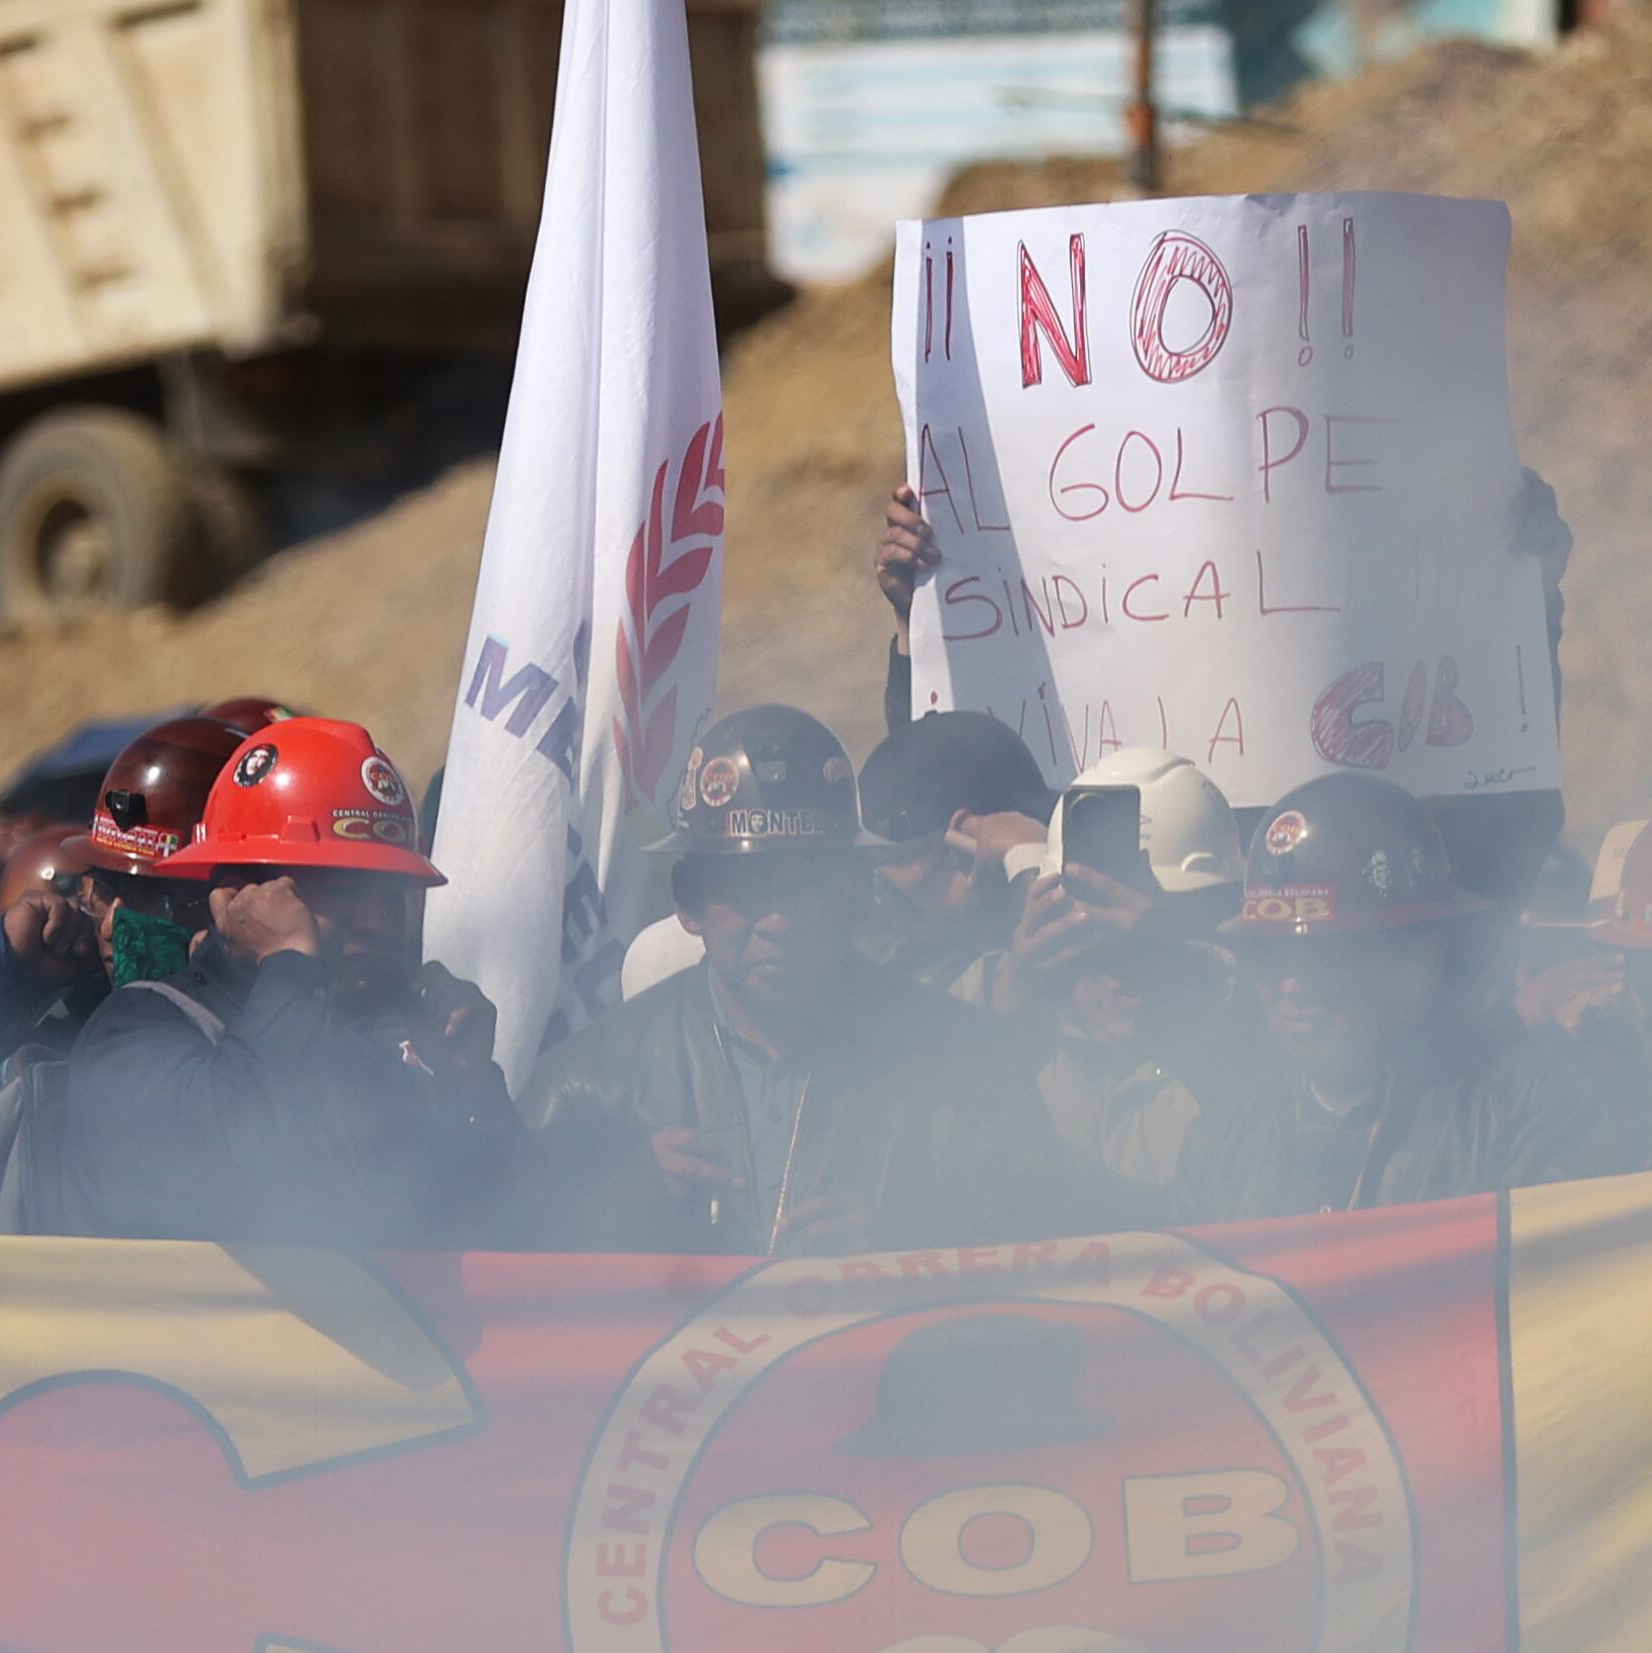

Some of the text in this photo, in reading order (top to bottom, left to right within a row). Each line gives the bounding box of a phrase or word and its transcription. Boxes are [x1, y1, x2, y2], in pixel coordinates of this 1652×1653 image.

[918, 406, 1402, 534] AL GOLPE
[1243, 897, 1331, 921] COB
[596, 1239, 1384, 1627] CENTRAL OBRERA BOLIVIANA
[693, 1468, 1300, 1608] COB
